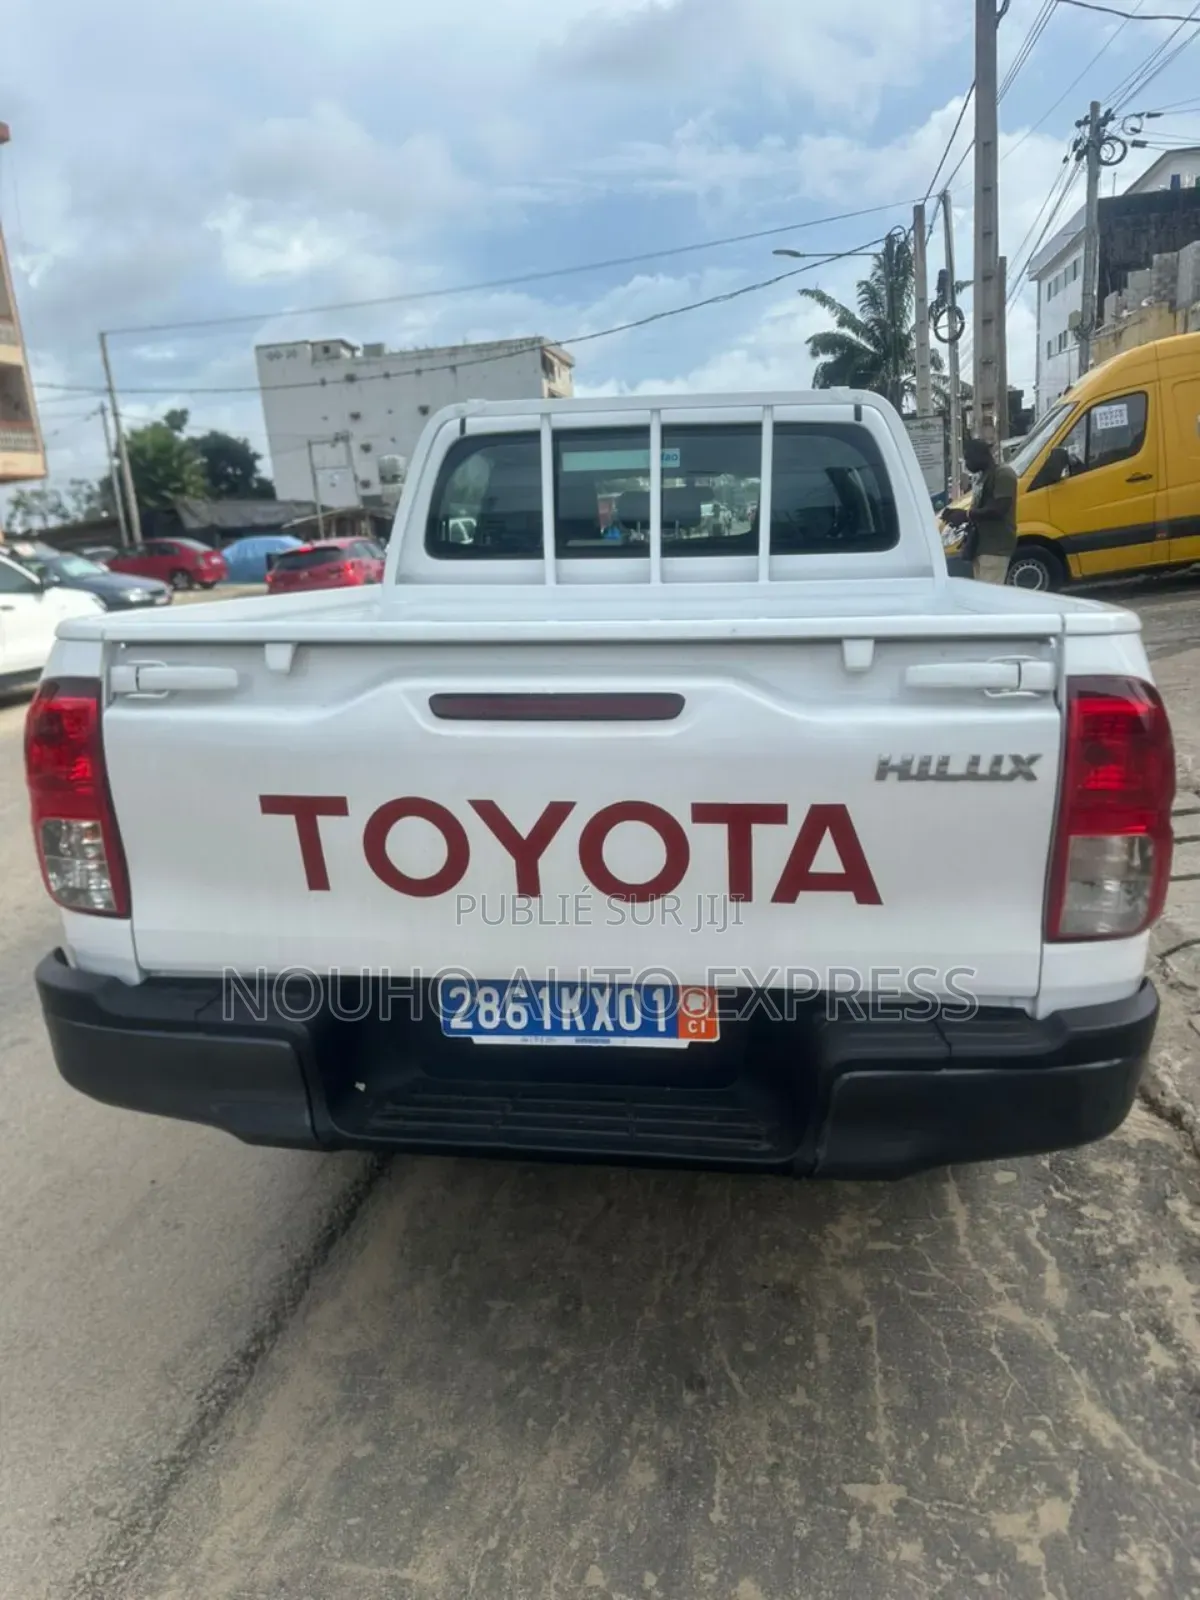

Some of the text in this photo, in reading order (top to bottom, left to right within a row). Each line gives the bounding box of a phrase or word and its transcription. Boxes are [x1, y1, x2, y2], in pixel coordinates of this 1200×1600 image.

[875, 753, 1043, 781] HILUX
[259, 794, 883, 905] TOYOTA
[687, 1020, 706, 1033] CI
